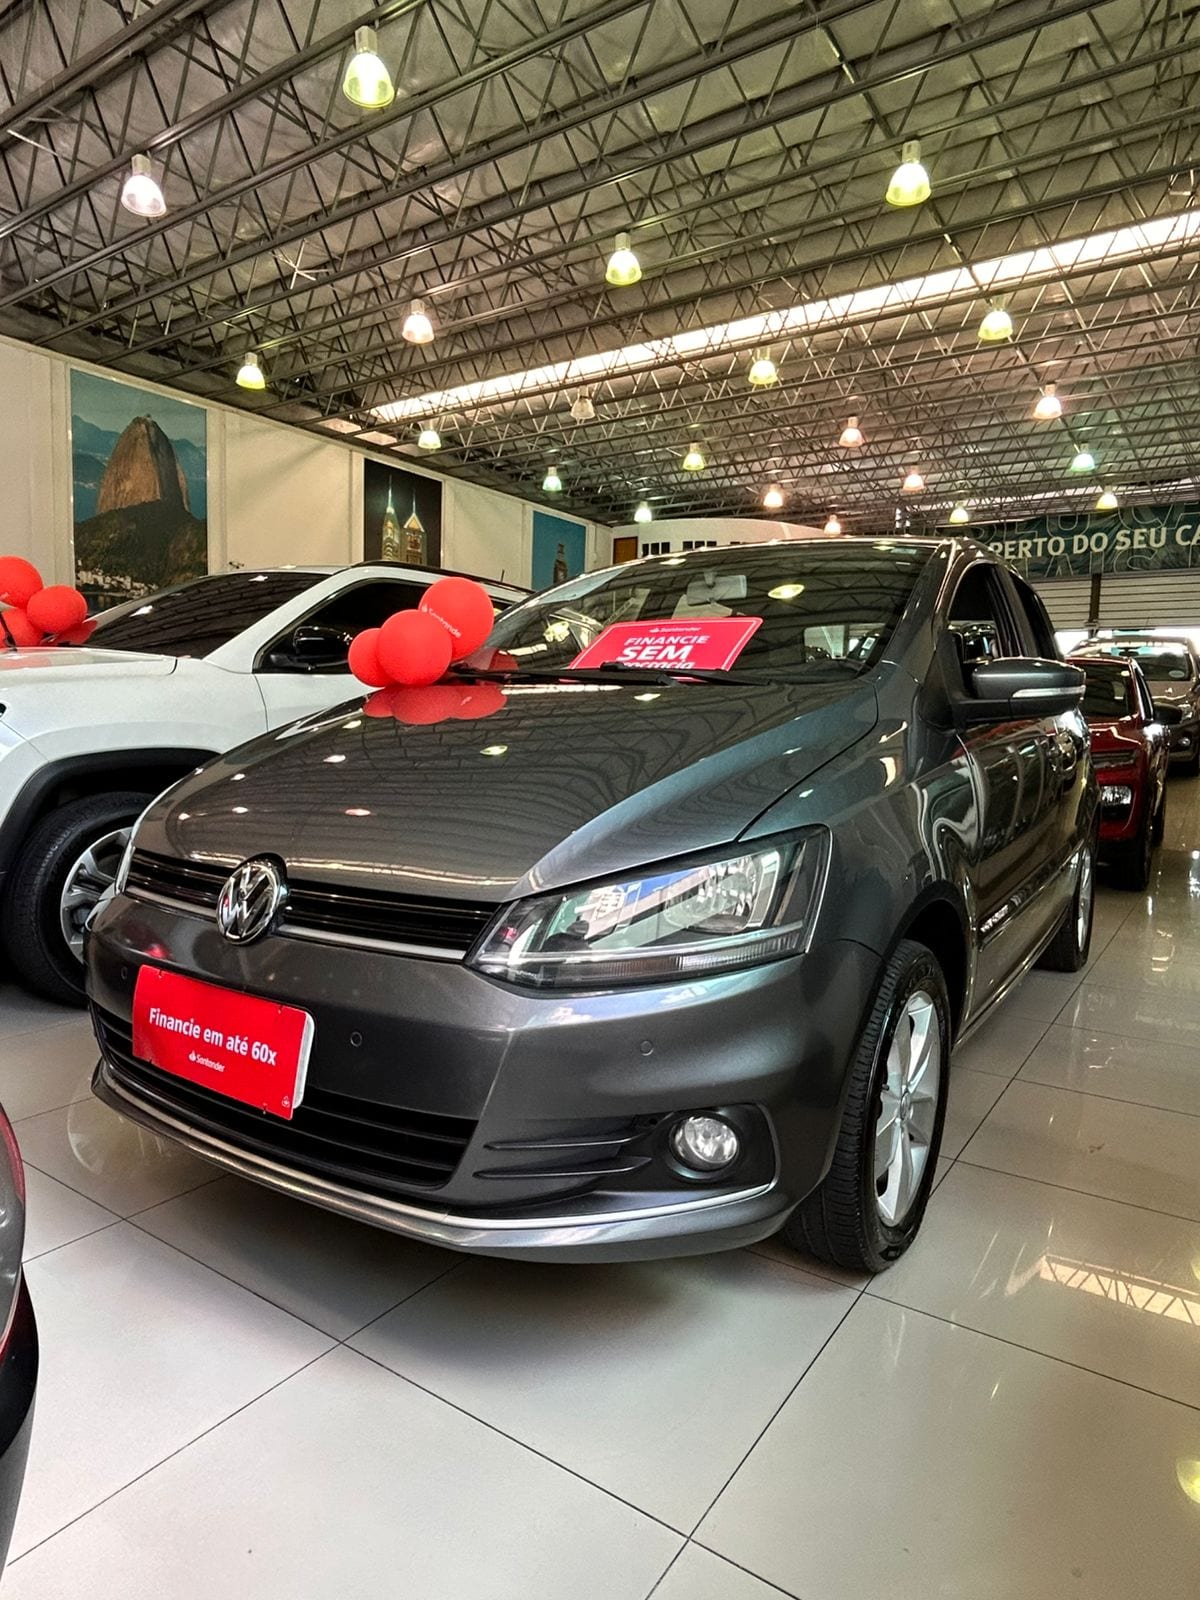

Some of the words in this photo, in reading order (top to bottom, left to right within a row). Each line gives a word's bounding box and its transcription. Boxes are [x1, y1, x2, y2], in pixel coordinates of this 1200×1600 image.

[990, 536, 1065, 559] PERTO
[1073, 532, 1108, 554] DO
[1115, 526, 1167, 550] SEU
[624, 635, 710, 645] FINANCIE
[616, 645, 694, 661] SEM
[149, 1007, 201, 1039] Financie
[203, 1028, 223, 1047] em
[226, 1035, 249, 1056] até
[251, 1041, 277, 1066] 60x
[196, 1054, 225, 1073] Santander
